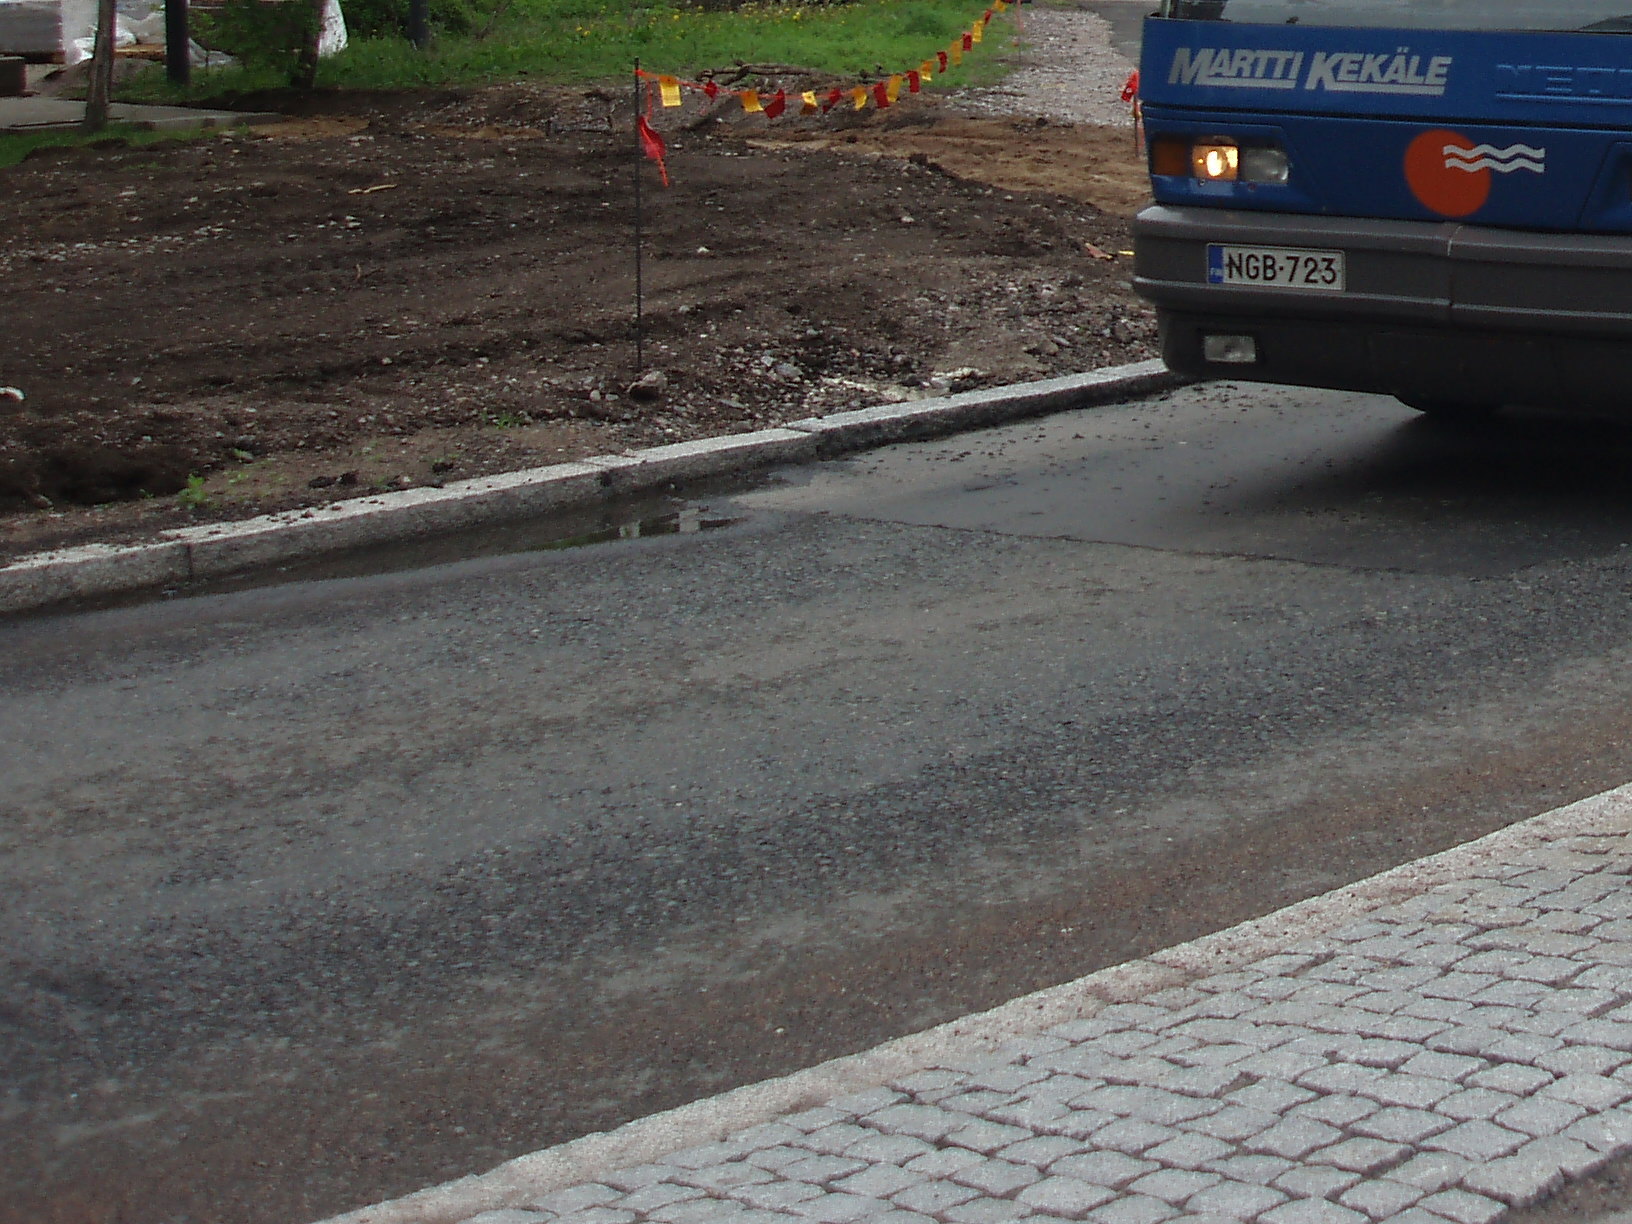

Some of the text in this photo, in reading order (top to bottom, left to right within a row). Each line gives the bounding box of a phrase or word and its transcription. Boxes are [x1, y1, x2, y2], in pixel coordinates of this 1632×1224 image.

[1167, 46, 1453, 96] MARTTI KEKÄLE
[1226, 253, 1337, 285] NGB-723
